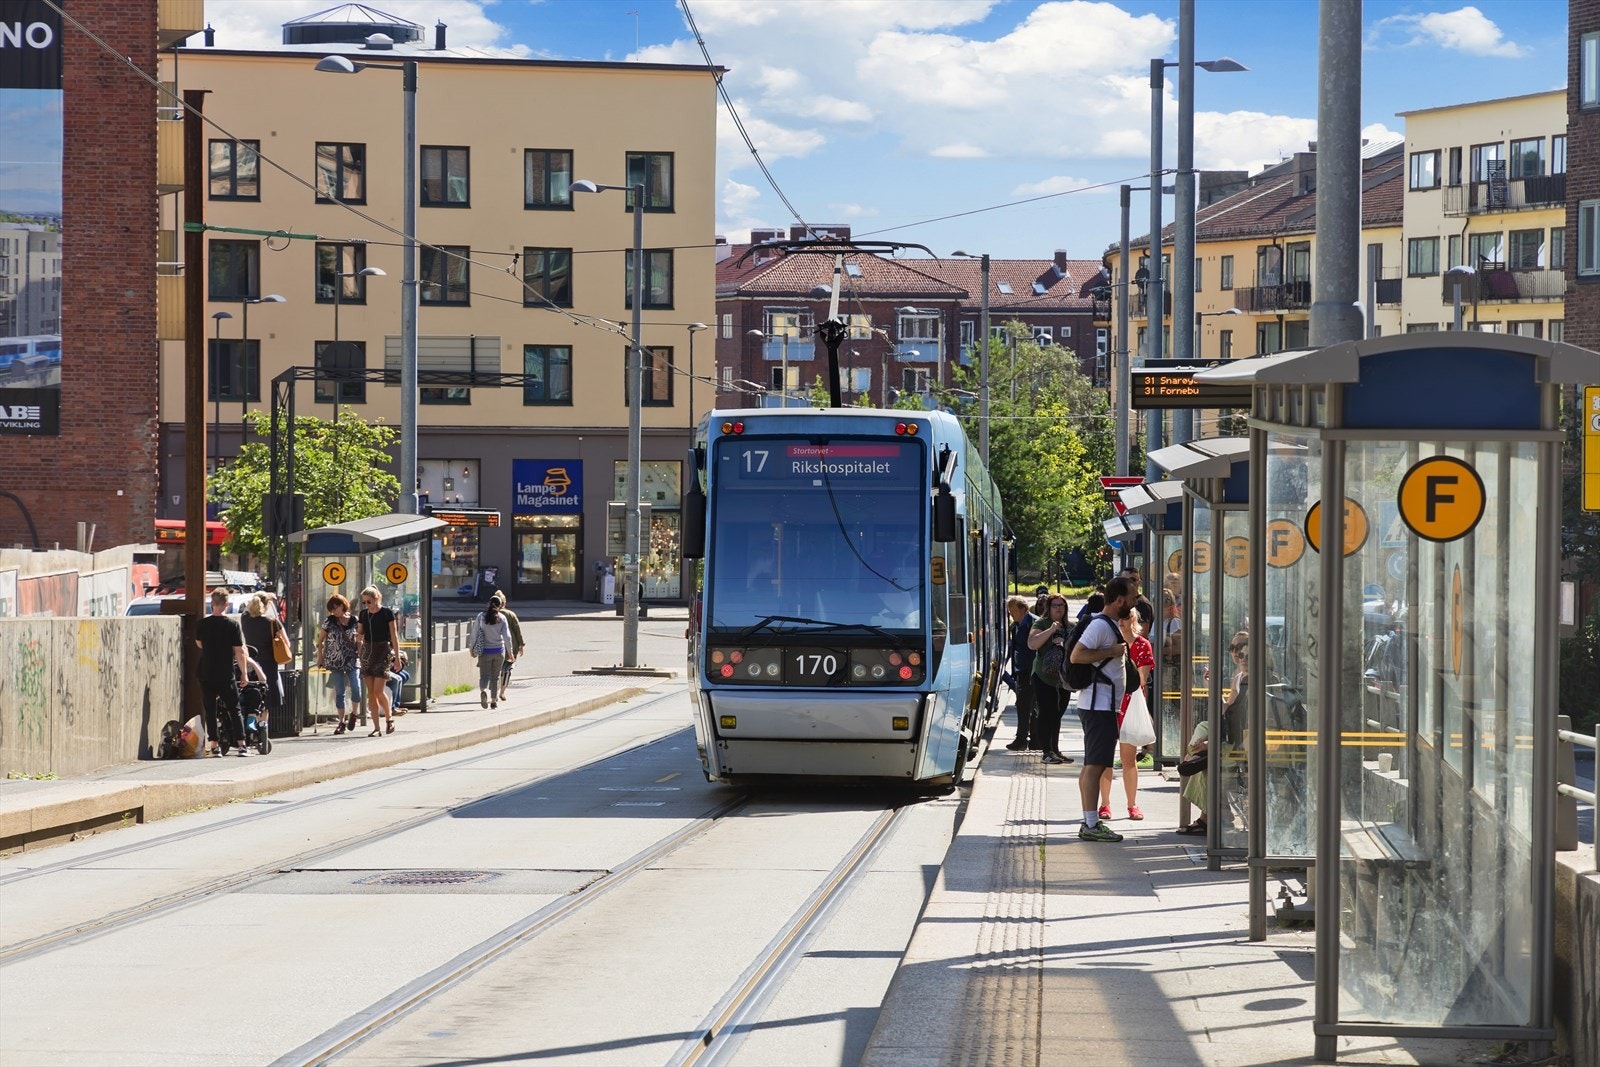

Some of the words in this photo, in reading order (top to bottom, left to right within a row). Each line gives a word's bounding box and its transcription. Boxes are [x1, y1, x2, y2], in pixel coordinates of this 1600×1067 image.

[0, 21, 53, 49] NO
[1144, 376, 1155, 385] 31
[1144, 387, 1155, 395] 31
[1160, 387, 1199, 395] Fornebu
[792, 447, 829, 455] Stortorvet
[742, 450, 769, 473] 17
[792, 460, 890, 476] Rikshospitalet
[517, 482, 556, 496] Lampe
[517, 494, 579, 507] Magasinet
[1425, 475, 1459, 523] F
[1271, 529, 1290, 557] F
[1231, 545, 1247, 569] F
[329, 567, 340, 581] C
[392, 567, 401, 580] C
[795, 654, 837, 676] 170
